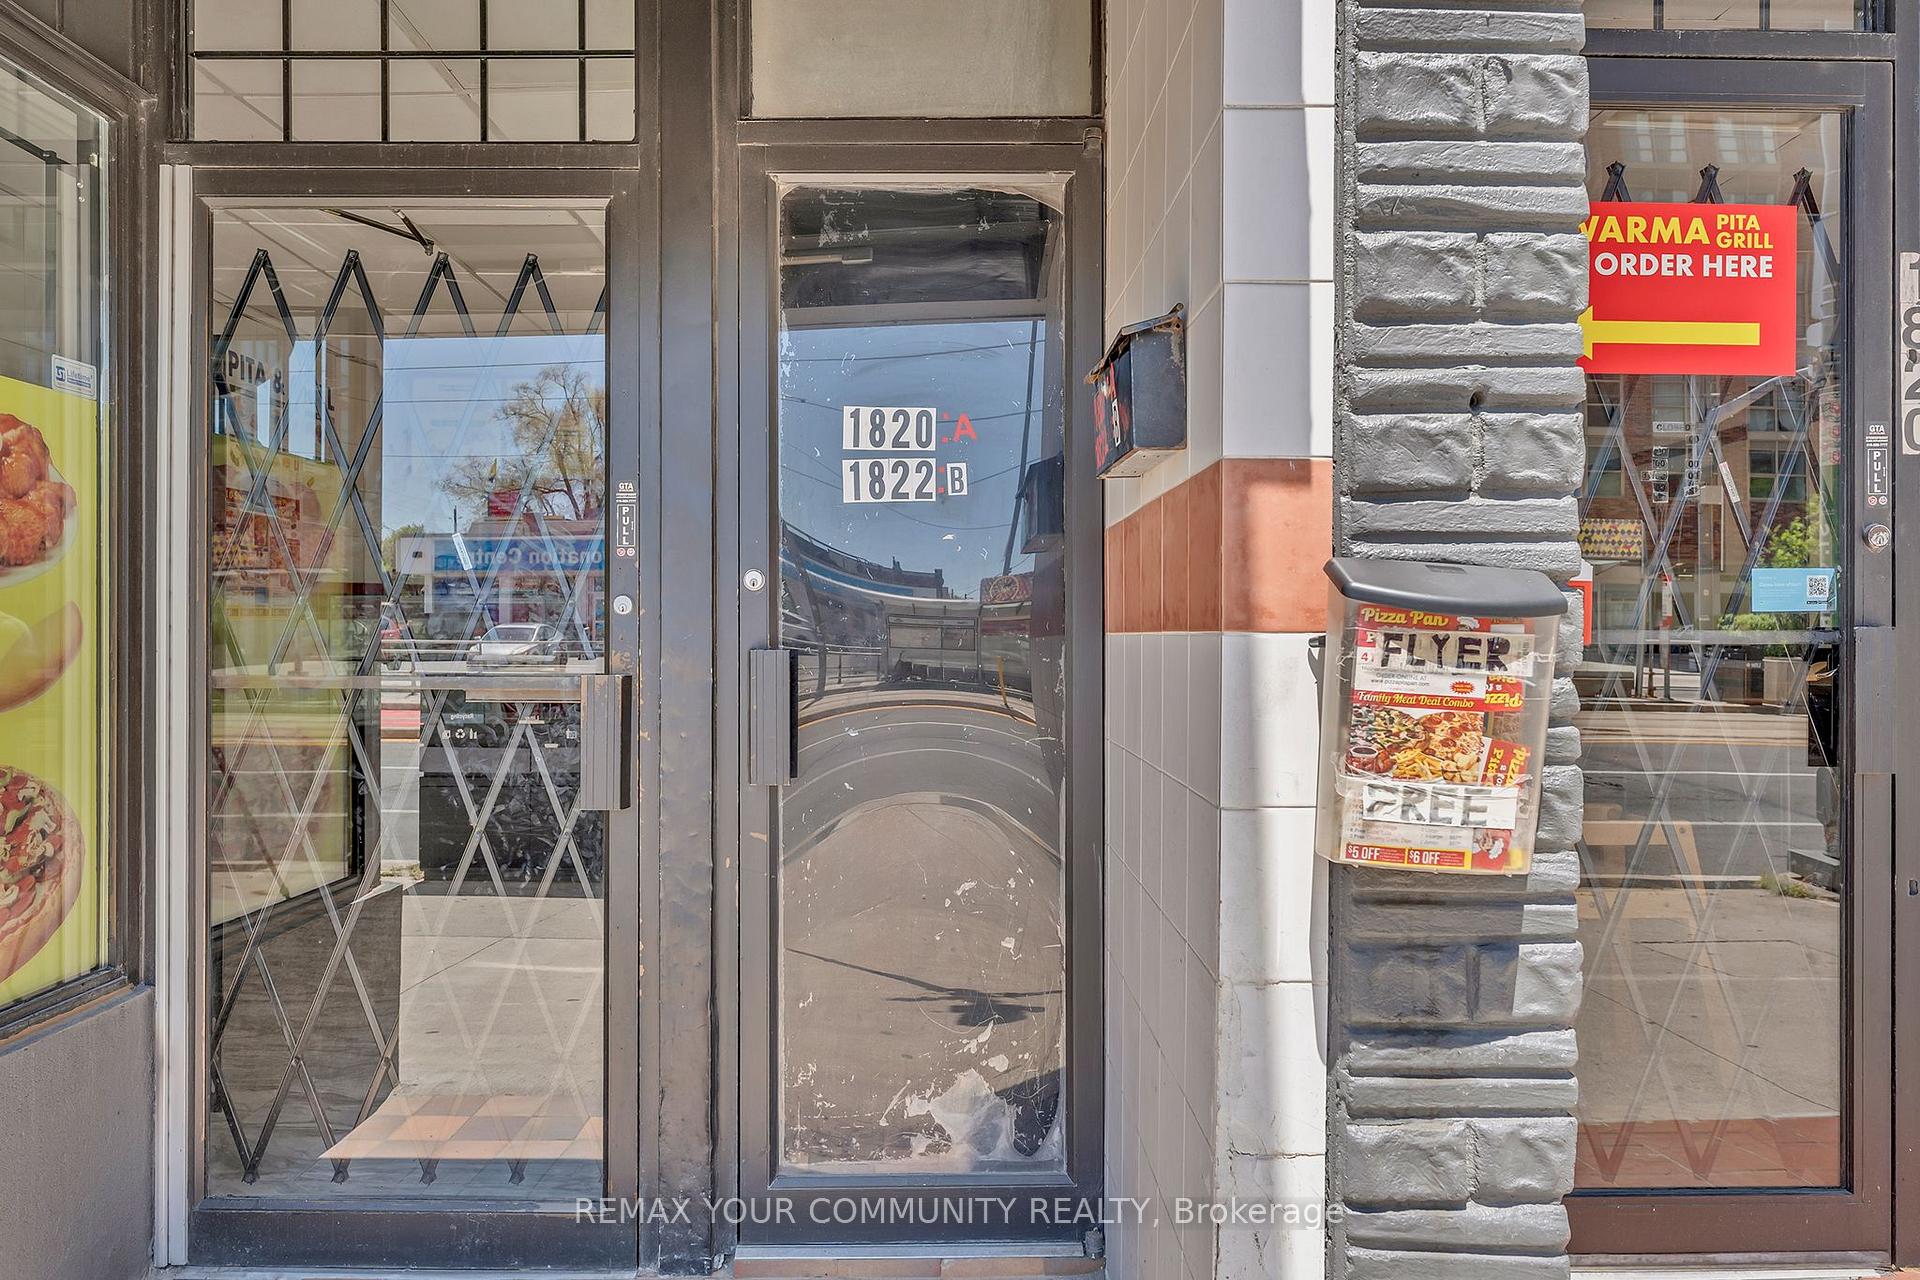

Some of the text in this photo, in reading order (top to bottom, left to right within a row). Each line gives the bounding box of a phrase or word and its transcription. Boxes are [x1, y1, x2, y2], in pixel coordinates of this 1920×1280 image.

[1717, 213, 1761, 231] PITA
[1716, 232, 1774, 249] GRILL
[1594, 252, 1773, 278] ORDER HERE
[228, 350, 266, 385] PITA
[849, 407, 933, 449] 1820
[1869, 424, 1885, 433] GTA
[849, 459, 934, 501] 1822
[1873, 450, 1882, 493] PULL
[618, 482, 634, 490] GTA
[622, 506, 630, 545] PULL
[1361, 607, 1449, 627] Pizza Pan
[1381, 632, 1511, 672] FLYER
[1356, 691, 1475, 709] Family Meat Deal Combo
[1366, 783, 1493, 826] FREE
[1347, 844, 1359, 859] $5
[1361, 846, 1381, 861] OFF
[1409, 849, 1421, 864] $6
[1422, 851, 1441, 865] OFF
